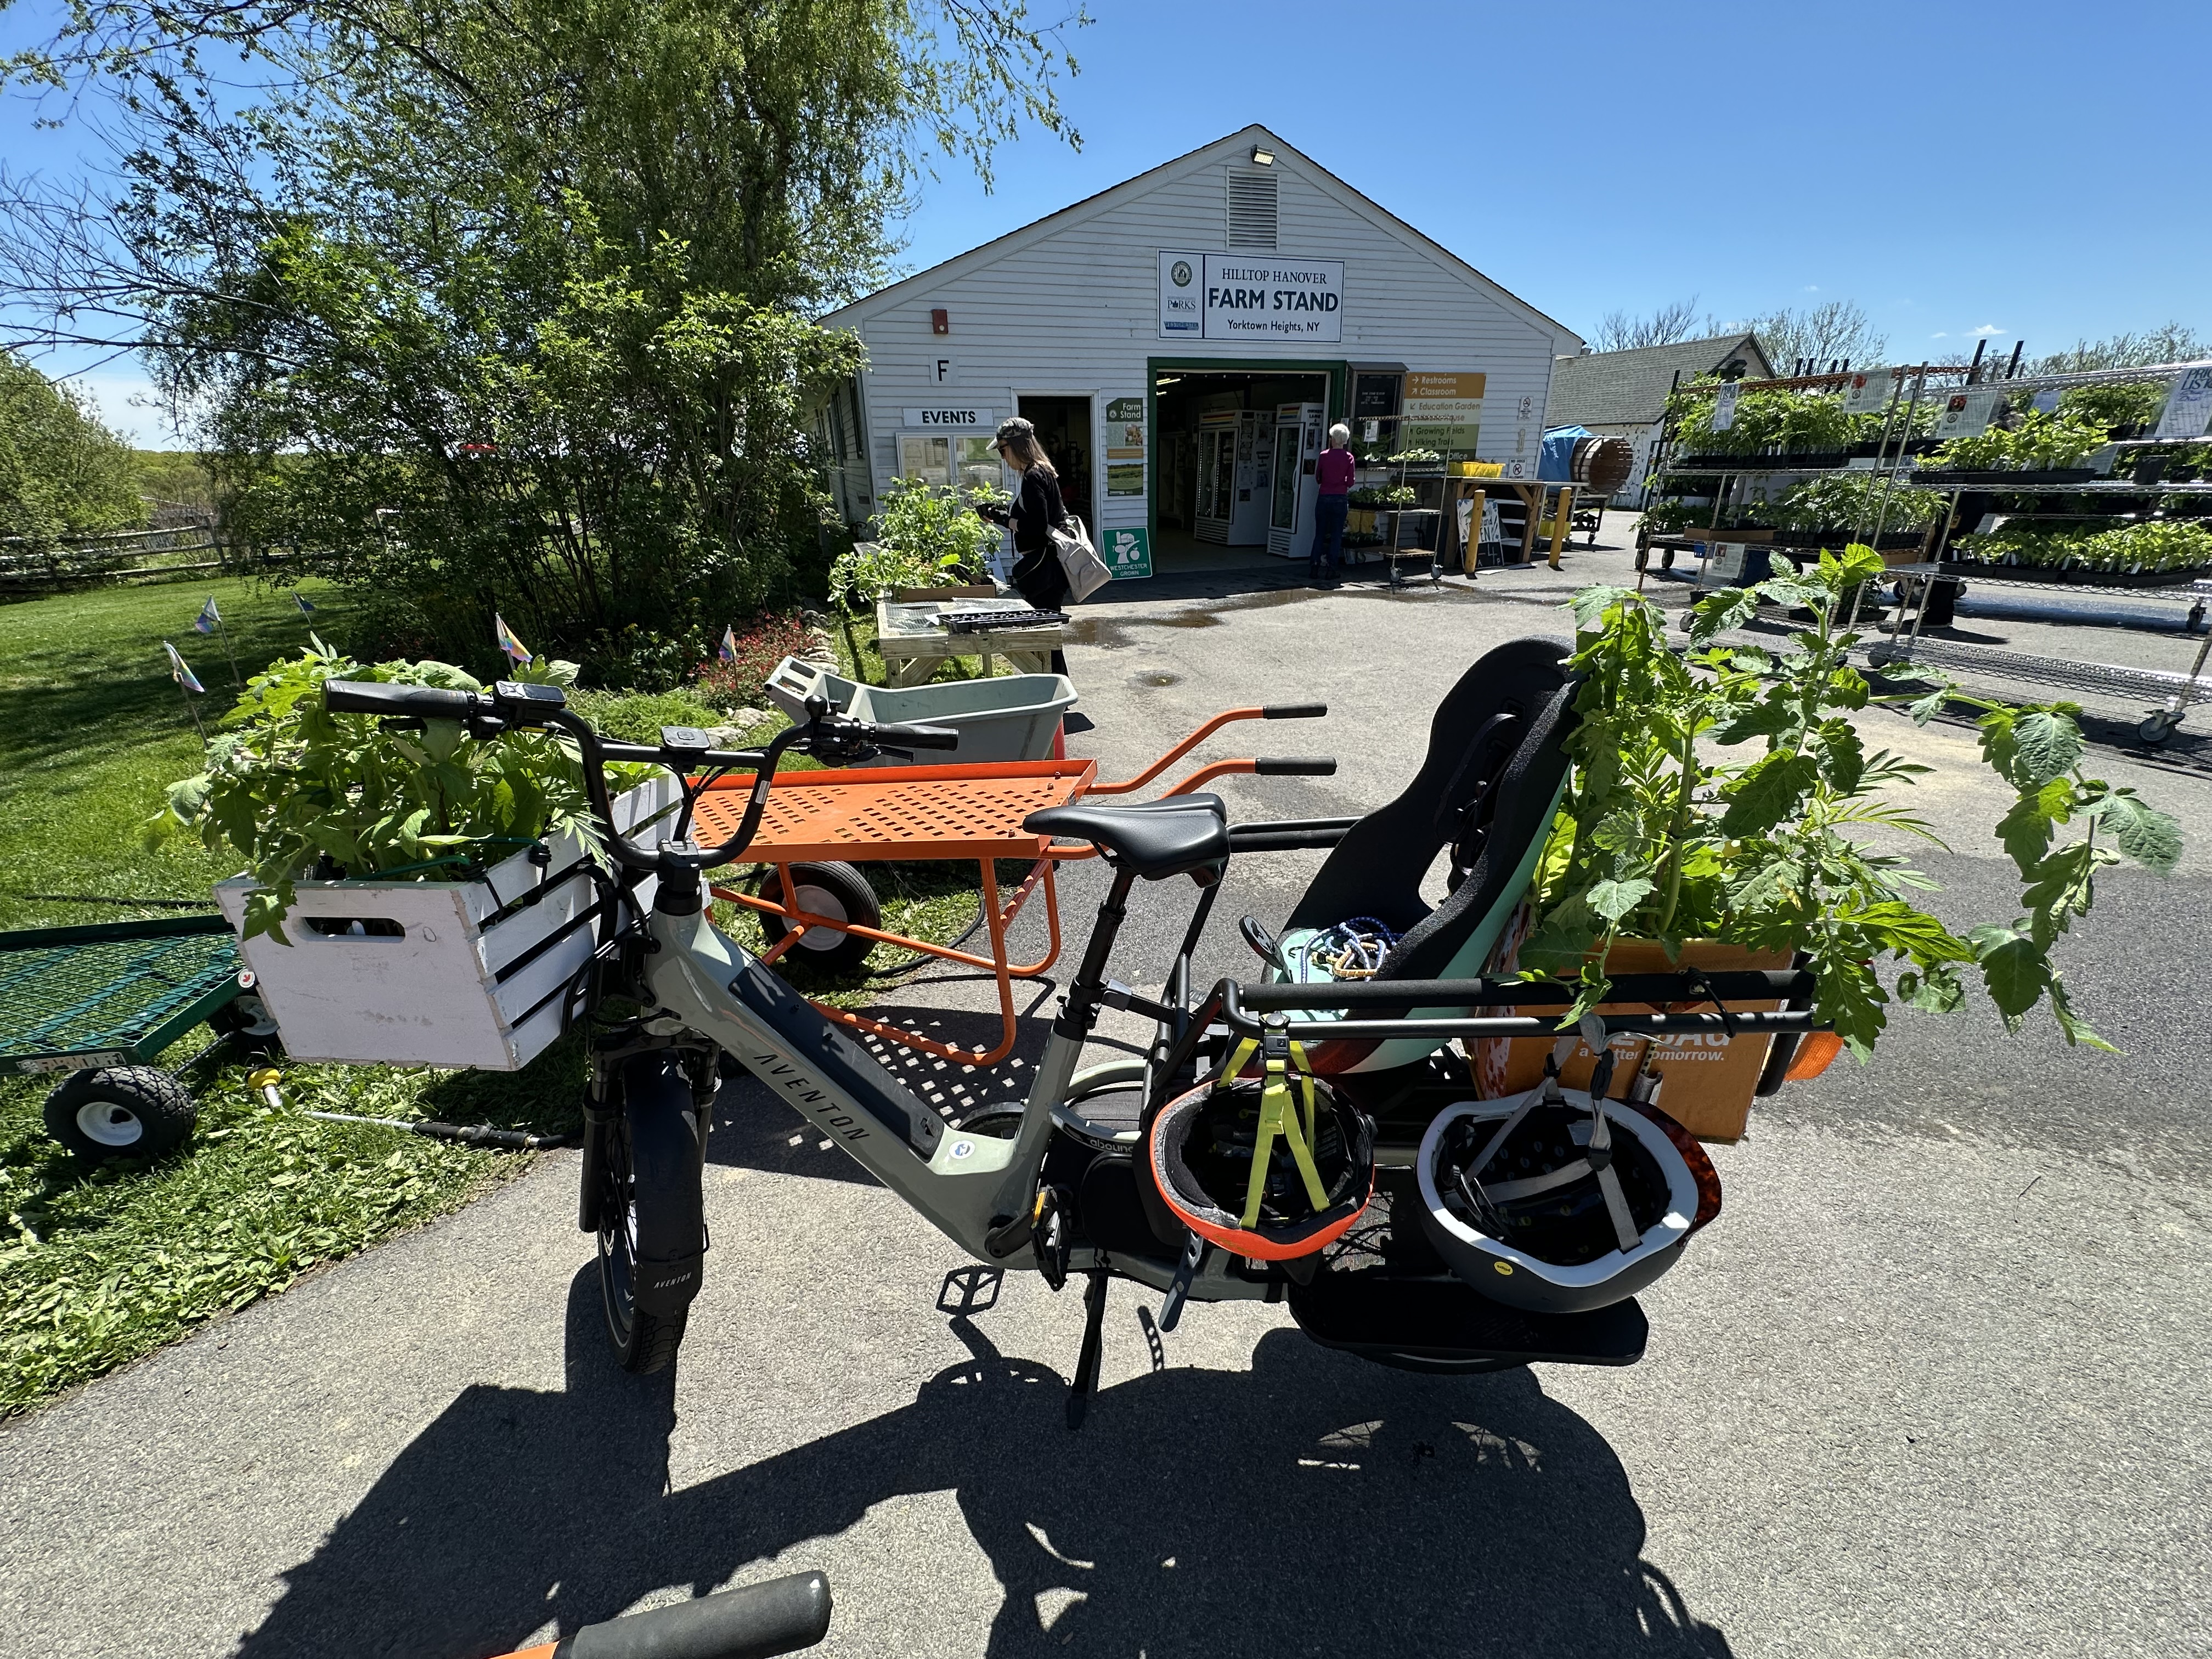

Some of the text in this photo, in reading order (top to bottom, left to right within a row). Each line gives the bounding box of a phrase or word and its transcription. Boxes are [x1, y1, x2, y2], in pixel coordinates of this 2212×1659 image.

[1222, 268, 1327, 284] HILLTOP HANOVER
[1209, 288, 1339, 312] FARM STAND
[1228, 320, 1320, 333] Yorktown Heights, NY
[937, 360, 949, 381] F
[2186, 368, 2212, 379] PRIC
[1419, 402, 1480, 410] Education Garden
[922, 410, 976, 424] EVENTS
[1416, 427, 1444, 436] Growing
[1415, 438, 1436, 447] Hiking
[1579, 1047, 1588, 1057] a
[1650, 1050, 1724, 1060] omorrow.
[753, 1053, 871, 1142] AVENTON
[654, 1272, 691, 1289] AVENTON
